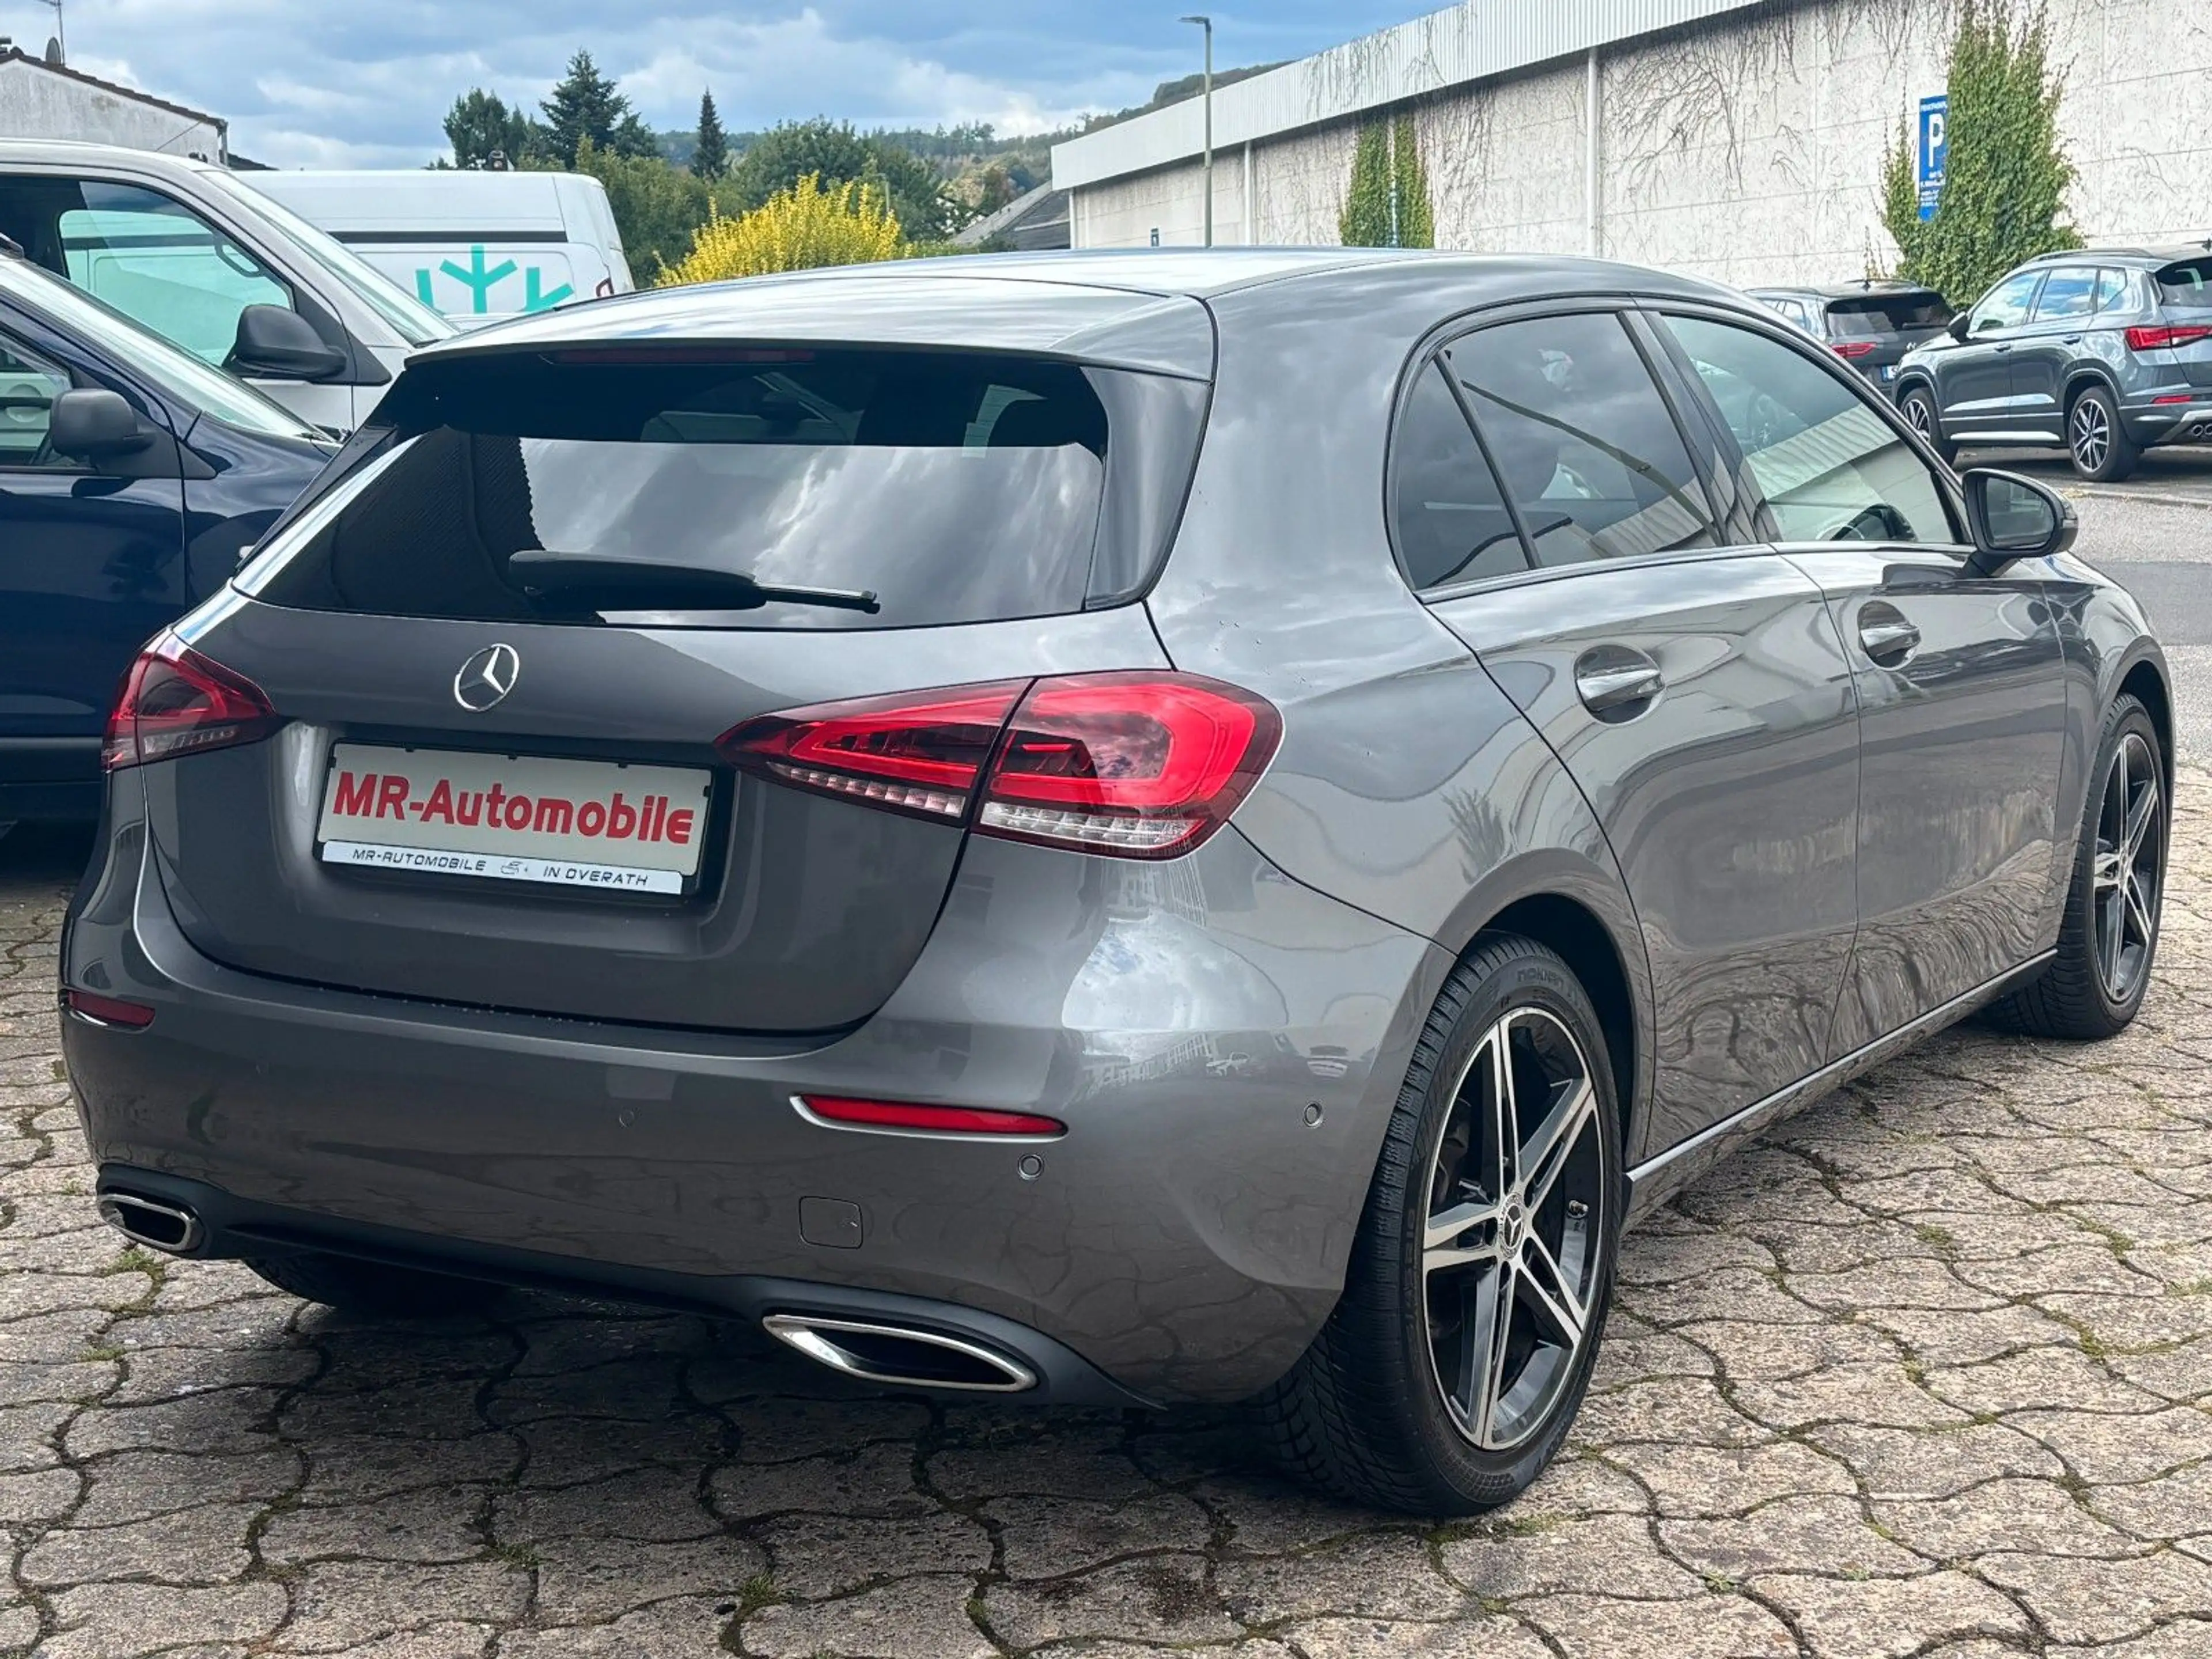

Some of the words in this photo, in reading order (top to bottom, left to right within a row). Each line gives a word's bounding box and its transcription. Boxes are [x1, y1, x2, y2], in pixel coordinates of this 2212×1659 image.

[1928, 113, 1945, 168] P
[334, 772, 694, 844] MR-Automobile
[353, 849, 486, 872] MR-AUTOMOBILE
[543, 866, 560, 878] IN
[565, 868, 649, 885] OVERATH
